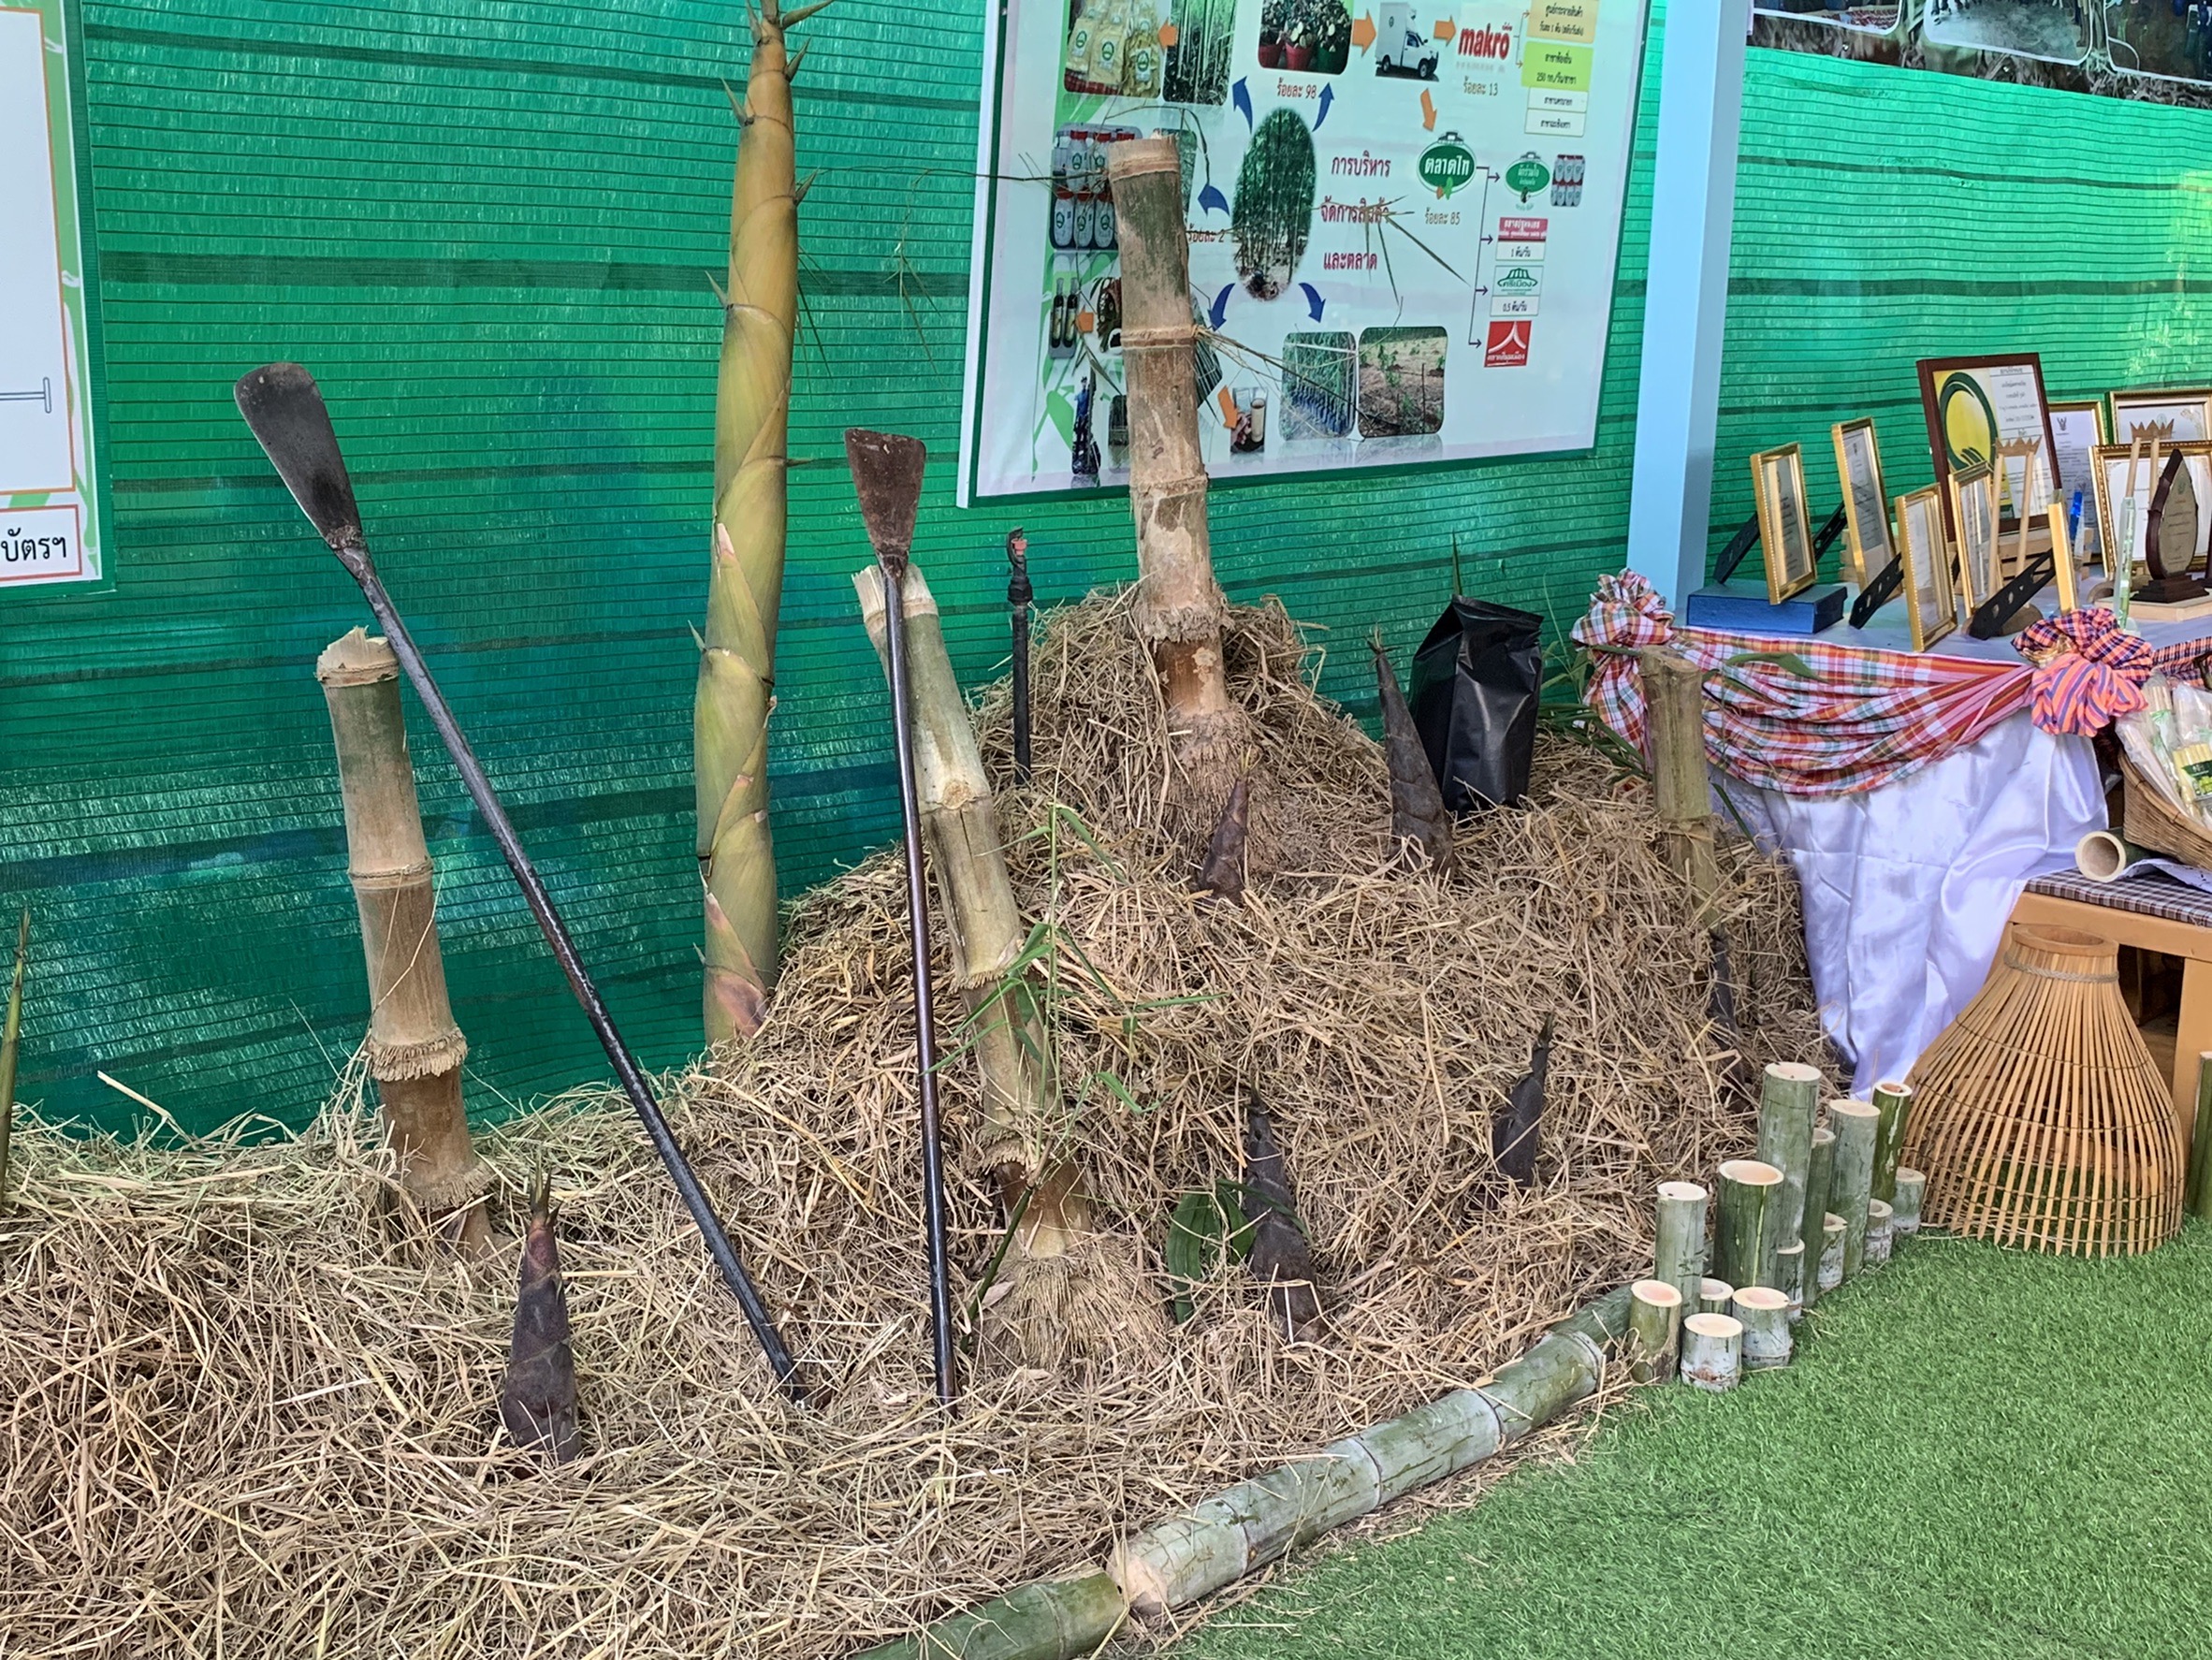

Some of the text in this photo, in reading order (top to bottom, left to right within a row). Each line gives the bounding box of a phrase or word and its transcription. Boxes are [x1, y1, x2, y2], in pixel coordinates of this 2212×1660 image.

[1277, 77, 1317, 99] ร้อยละ 98
[1463, 75, 1499, 95] ร้อยละ 13
[1331, 150, 1391, 178] การบริหาร
[1424, 154, 1470, 176] ตลาดไท
[1424, 207, 1461, 226] ร้อยละ 85
[1323, 252, 1377, 270] และตลาด
[0, 527, 66, 562] บัตรฯ
